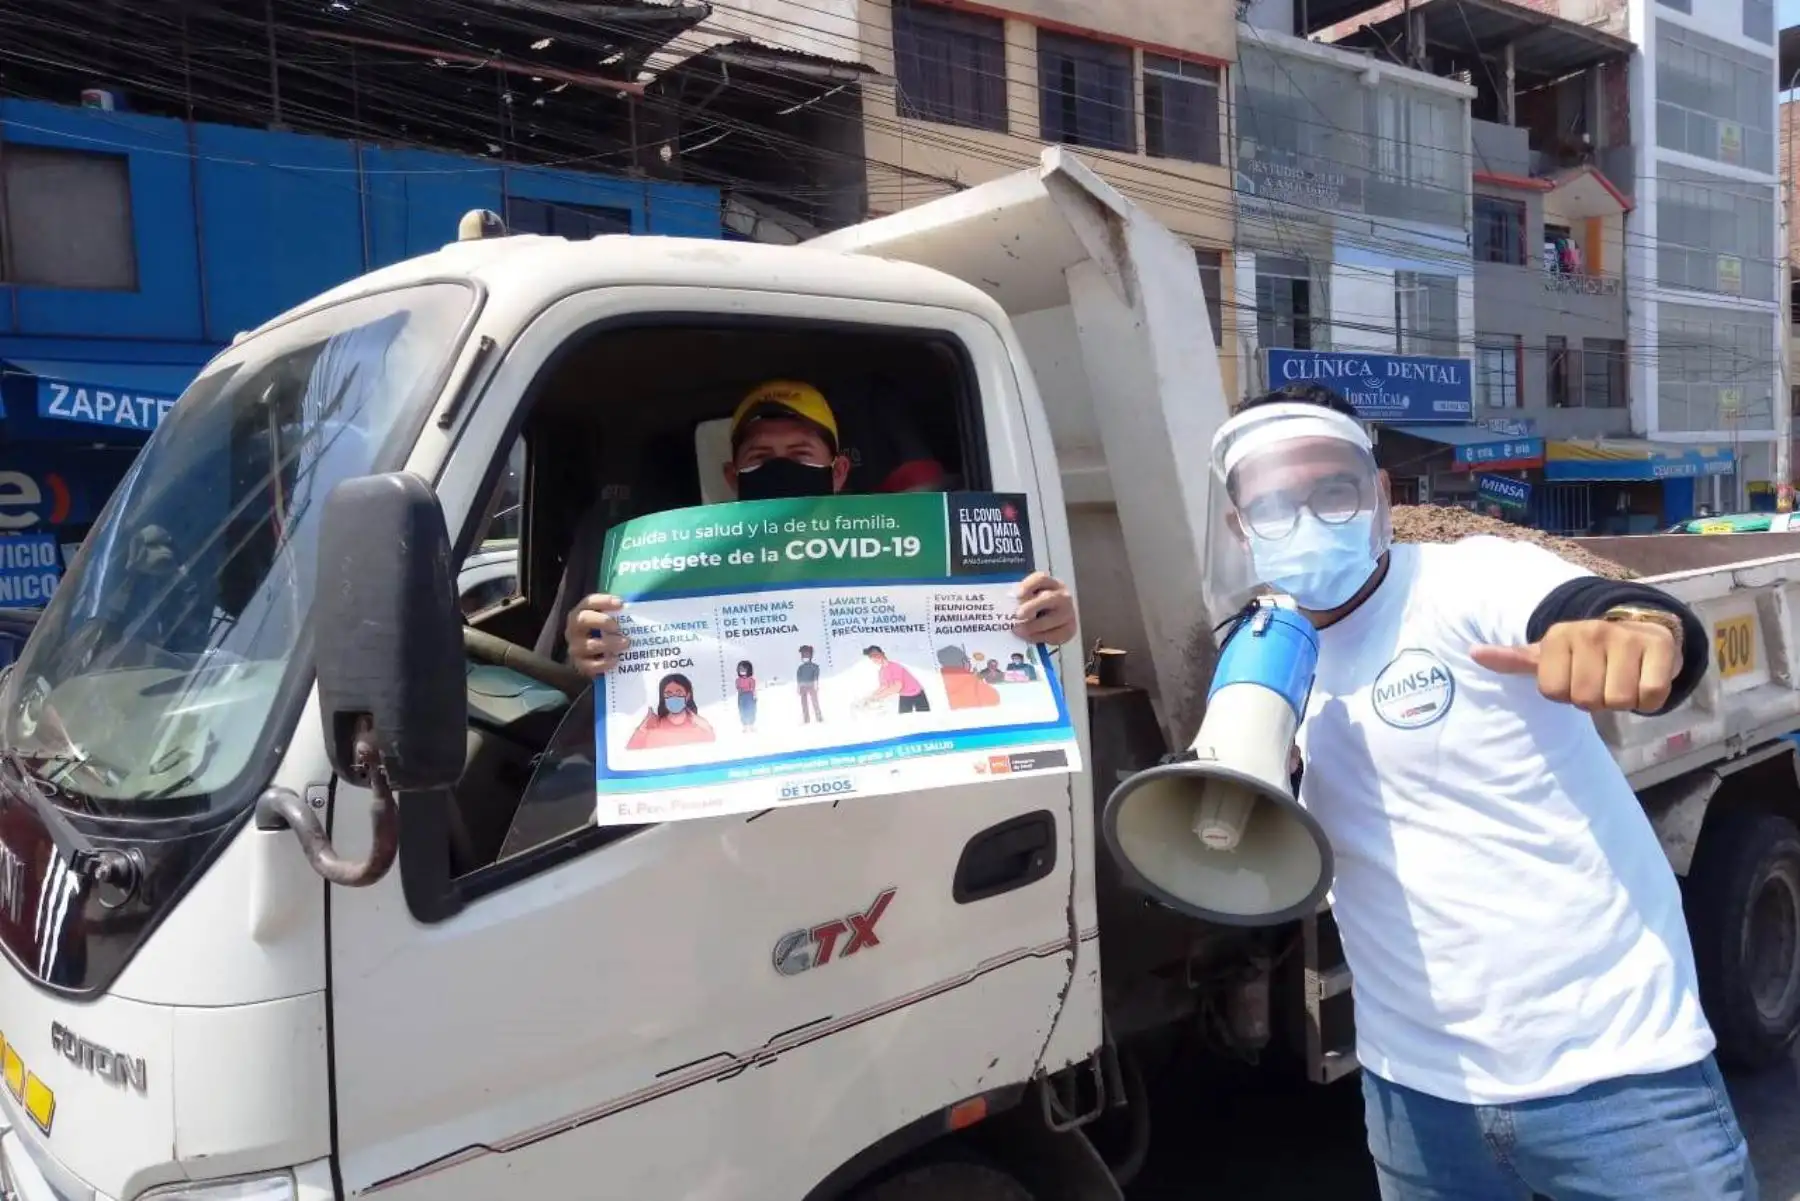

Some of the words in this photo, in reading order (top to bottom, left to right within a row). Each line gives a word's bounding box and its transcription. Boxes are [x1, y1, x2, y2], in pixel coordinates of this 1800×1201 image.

[1282, 353, 1374, 381] CLÍNICA
[1387, 361, 1462, 385] DENTAL
[1481, 477, 1525, 500] MINSA
[960, 508, 972, 522] EL
[974, 508, 1002, 522] COVID
[621, 529, 668, 550] Cuida
[671, 529, 690, 542] tu
[695, 520, 744, 540] salud
[747, 523, 759, 538] y
[764, 519, 779, 535] la
[784, 518, 807, 533] de
[811, 517, 831, 532] tu
[835, 513, 901, 530] familia.
[993, 522, 1020, 537] MATA
[961, 522, 995, 556] NO
[995, 537, 1023, 554] SOLO
[728, 548, 754, 565] de
[761, 547, 779, 563] la
[785, 536, 921, 561] COVID-19
[870, 595, 888, 604] LAS
[934, 593, 963, 601] EVITA
[965, 593, 986, 601] LAS
[829, 606, 869, 617] MANOS
[871, 604, 895, 615] CON
[934, 603, 995, 612] REUNIONES
[723, 617, 739, 628] DE
[750, 613, 788, 626] METRO
[831, 616, 860, 627] AGUA
[861, 616, 869, 625] Y
[934, 613, 994, 623] FAMILIARES
[996, 613, 1004, 621] Y
[725, 629, 741, 639] DE
[742, 624, 800, 637] DISTANCIA
[831, 623, 926, 637] FRECUENTEMENTE
[618, 646, 682, 662] CUBRIENDO
[618, 662, 651, 675] NARIZ
[653, 661, 661, 670] Y
[663, 657, 695, 670] BOCA
[1376, 665, 1447, 703] MINSA
[781, 786, 799, 797] DE
[803, 779, 853, 795] TODOS
[51, 1021, 149, 1094] FOTON
